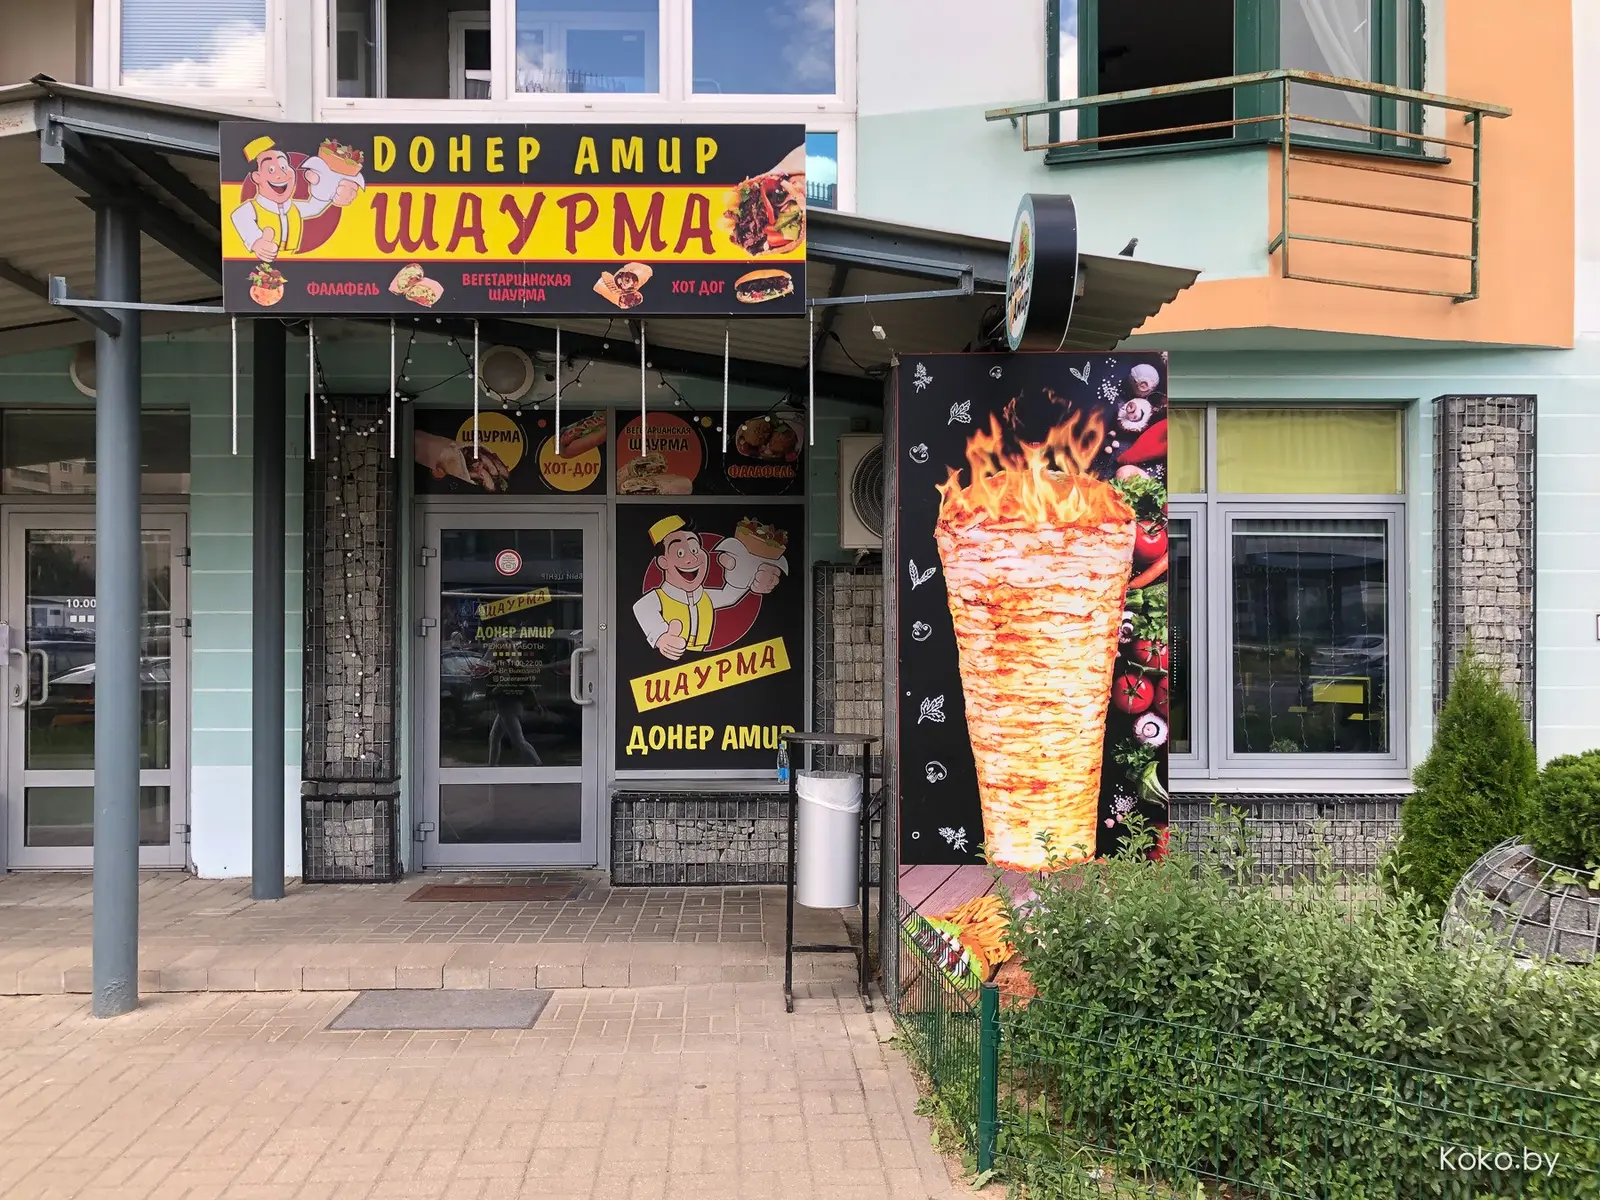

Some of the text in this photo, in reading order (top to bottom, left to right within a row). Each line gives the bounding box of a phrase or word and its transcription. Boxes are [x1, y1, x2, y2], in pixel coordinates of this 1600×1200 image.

[370, 191, 717, 257] ШАУРМА
[462, 273, 572, 287] ВЕГЕТАРИАНСКАЯ
[306, 281, 380, 296] ФАЛАФЕЛЬ
[488, 288, 546, 302] ШАУРМА
[671, 280, 725, 296] ХОТ ДОГ
[543, 462, 600, 477] ХОТ-ДОГ
[727, 464, 796, 478] ФАЛАФЕЛЬ
[485, 590, 546, 617] ШАУРМА
[475, 626, 555, 641] ДОНЕР АМИР
[644, 645, 777, 703] ШАУРМА
[626, 724, 715, 755] ДОНЕР
